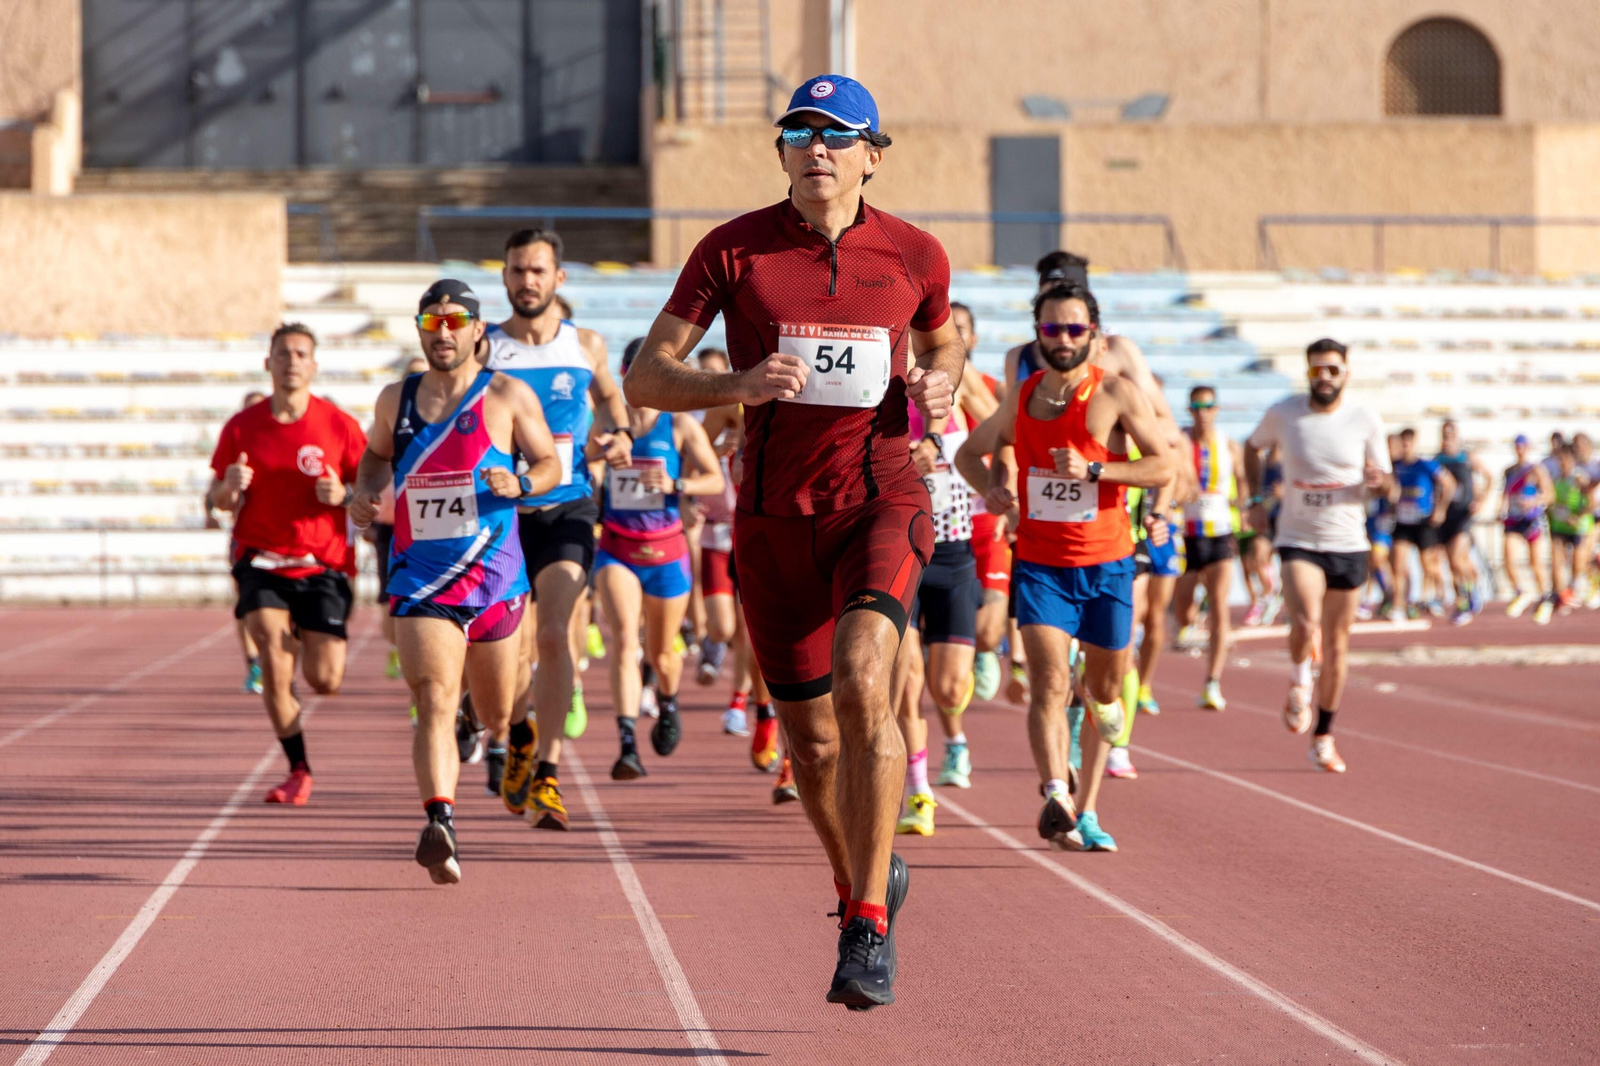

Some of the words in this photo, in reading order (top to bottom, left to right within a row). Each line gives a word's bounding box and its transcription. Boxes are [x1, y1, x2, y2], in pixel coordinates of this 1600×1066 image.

[816, 85, 827, 93] C
[782, 324, 821, 336] XXXVI
[815, 345, 855, 374] 54
[1041, 481, 1082, 502] 425
[416, 497, 466, 519] 774
